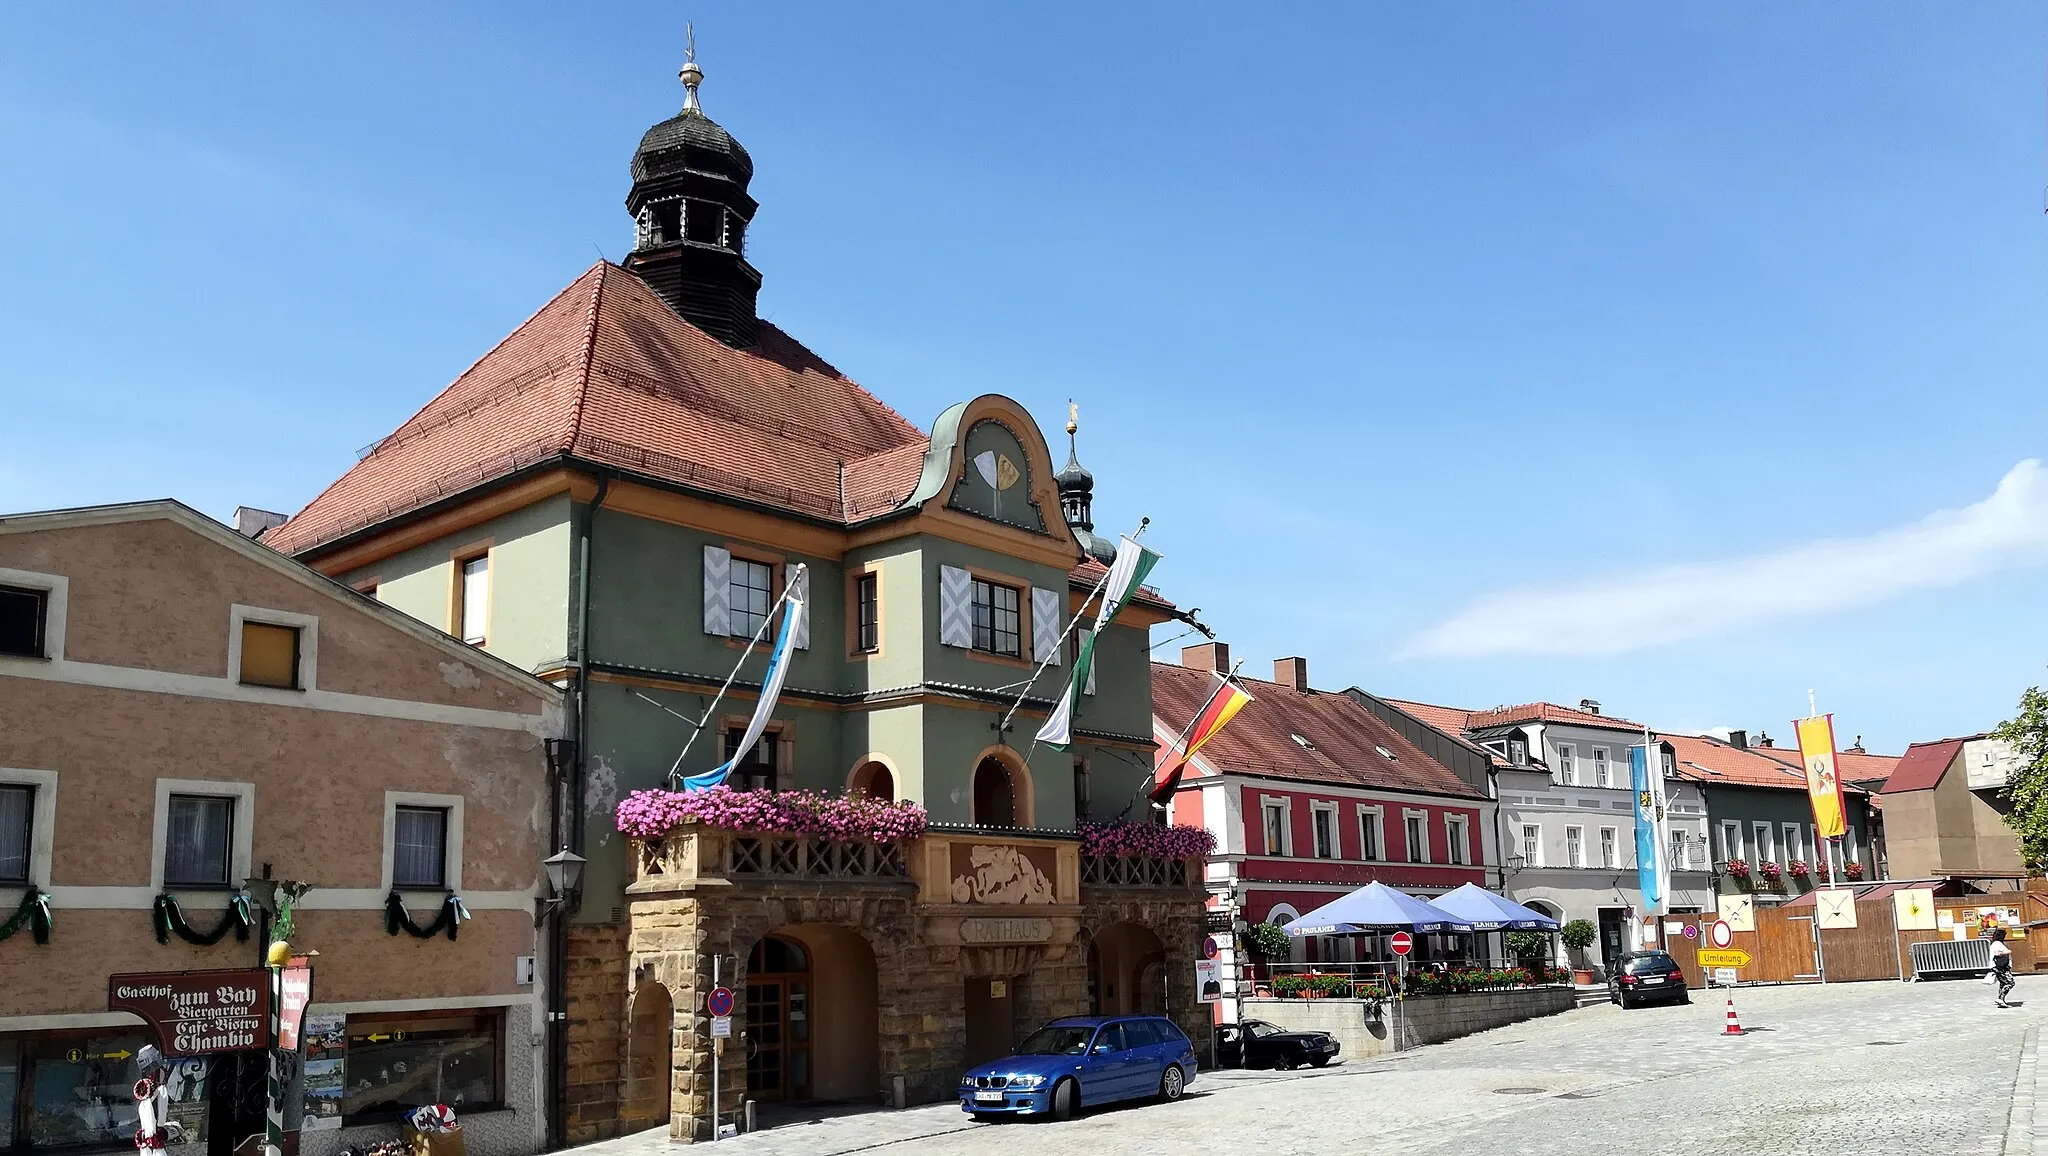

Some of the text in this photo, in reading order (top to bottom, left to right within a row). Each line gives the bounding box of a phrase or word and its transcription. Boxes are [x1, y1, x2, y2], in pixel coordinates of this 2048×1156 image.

[974, 921, 1040, 940] RATHAUS
[1301, 924, 1336, 935] PAULANER
[1704, 954, 1742, 964] Umleitung
[117, 984, 257, 1010] Gasthof zum Bay
[177, 1005, 249, 1020] Biergarten
[174, 1031, 254, 1053] Chambio
